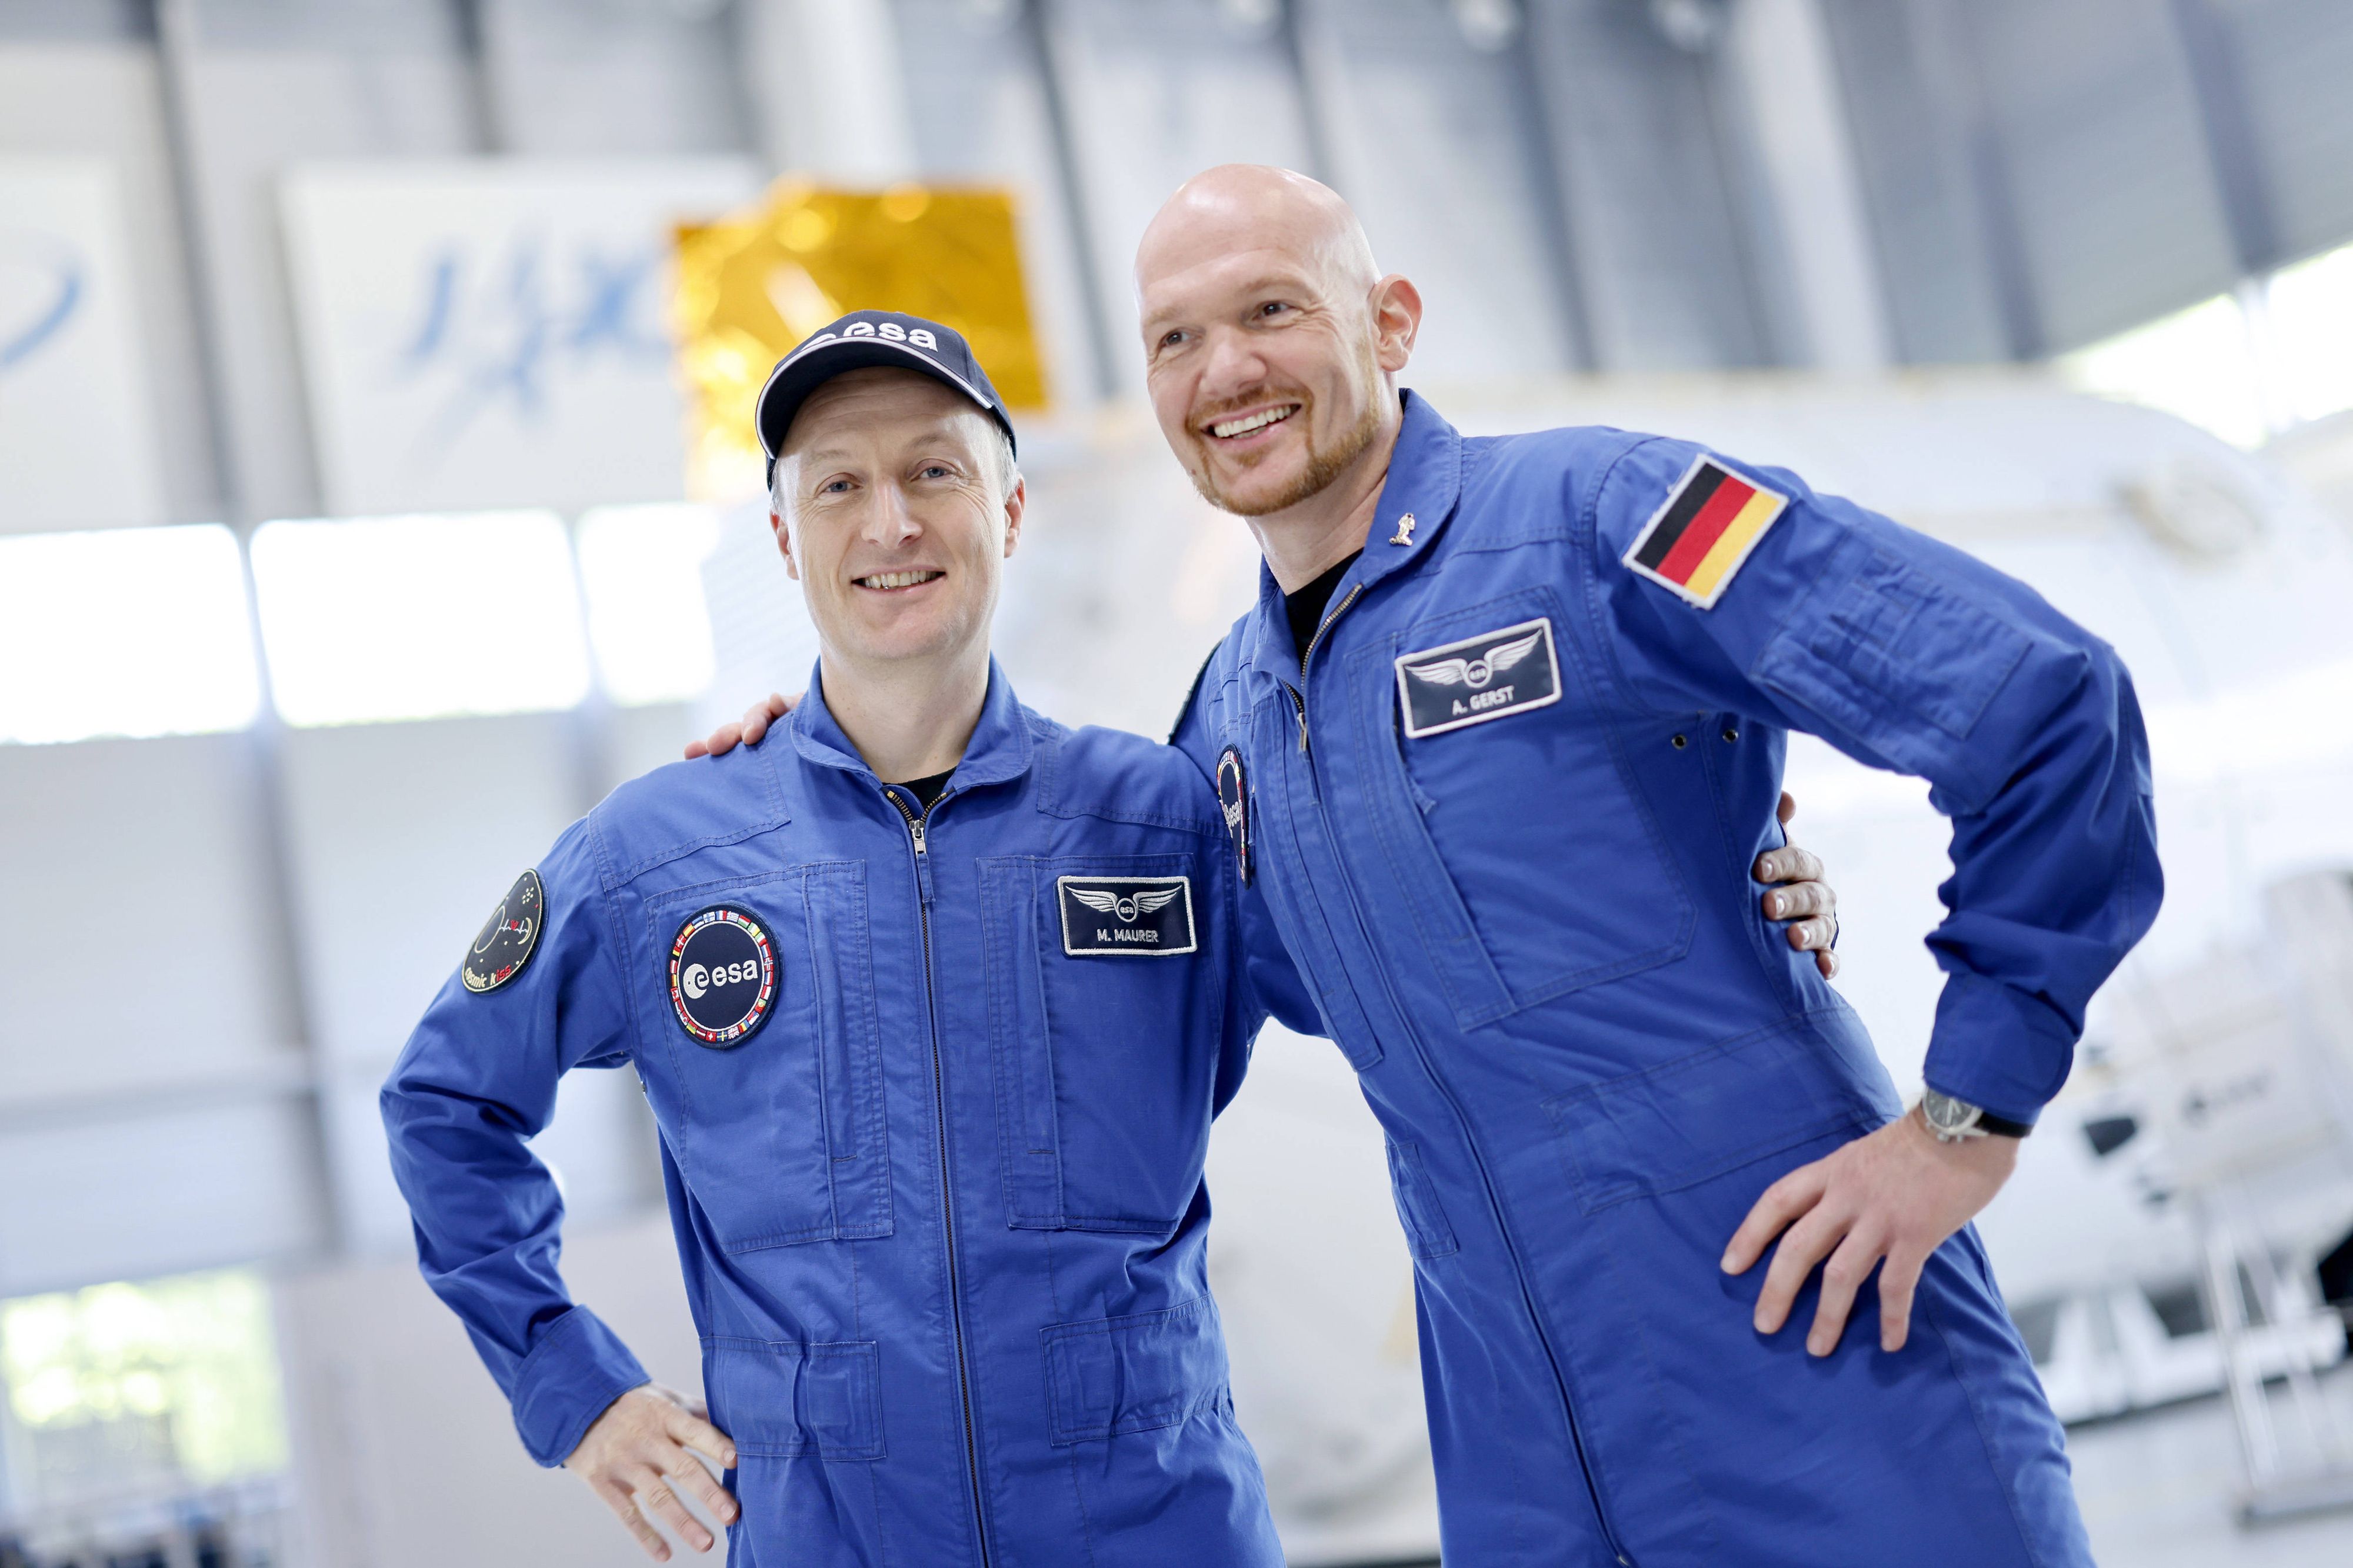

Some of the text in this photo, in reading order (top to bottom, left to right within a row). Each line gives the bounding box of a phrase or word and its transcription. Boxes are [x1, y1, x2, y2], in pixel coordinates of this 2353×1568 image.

[843, 321, 938, 352] esa
[1452, 685, 1515, 716] A. GERST
[1119, 906, 1135, 915] esa
[1096, 929, 1159, 943] M. MAURER
[712, 959, 759, 987] esa
